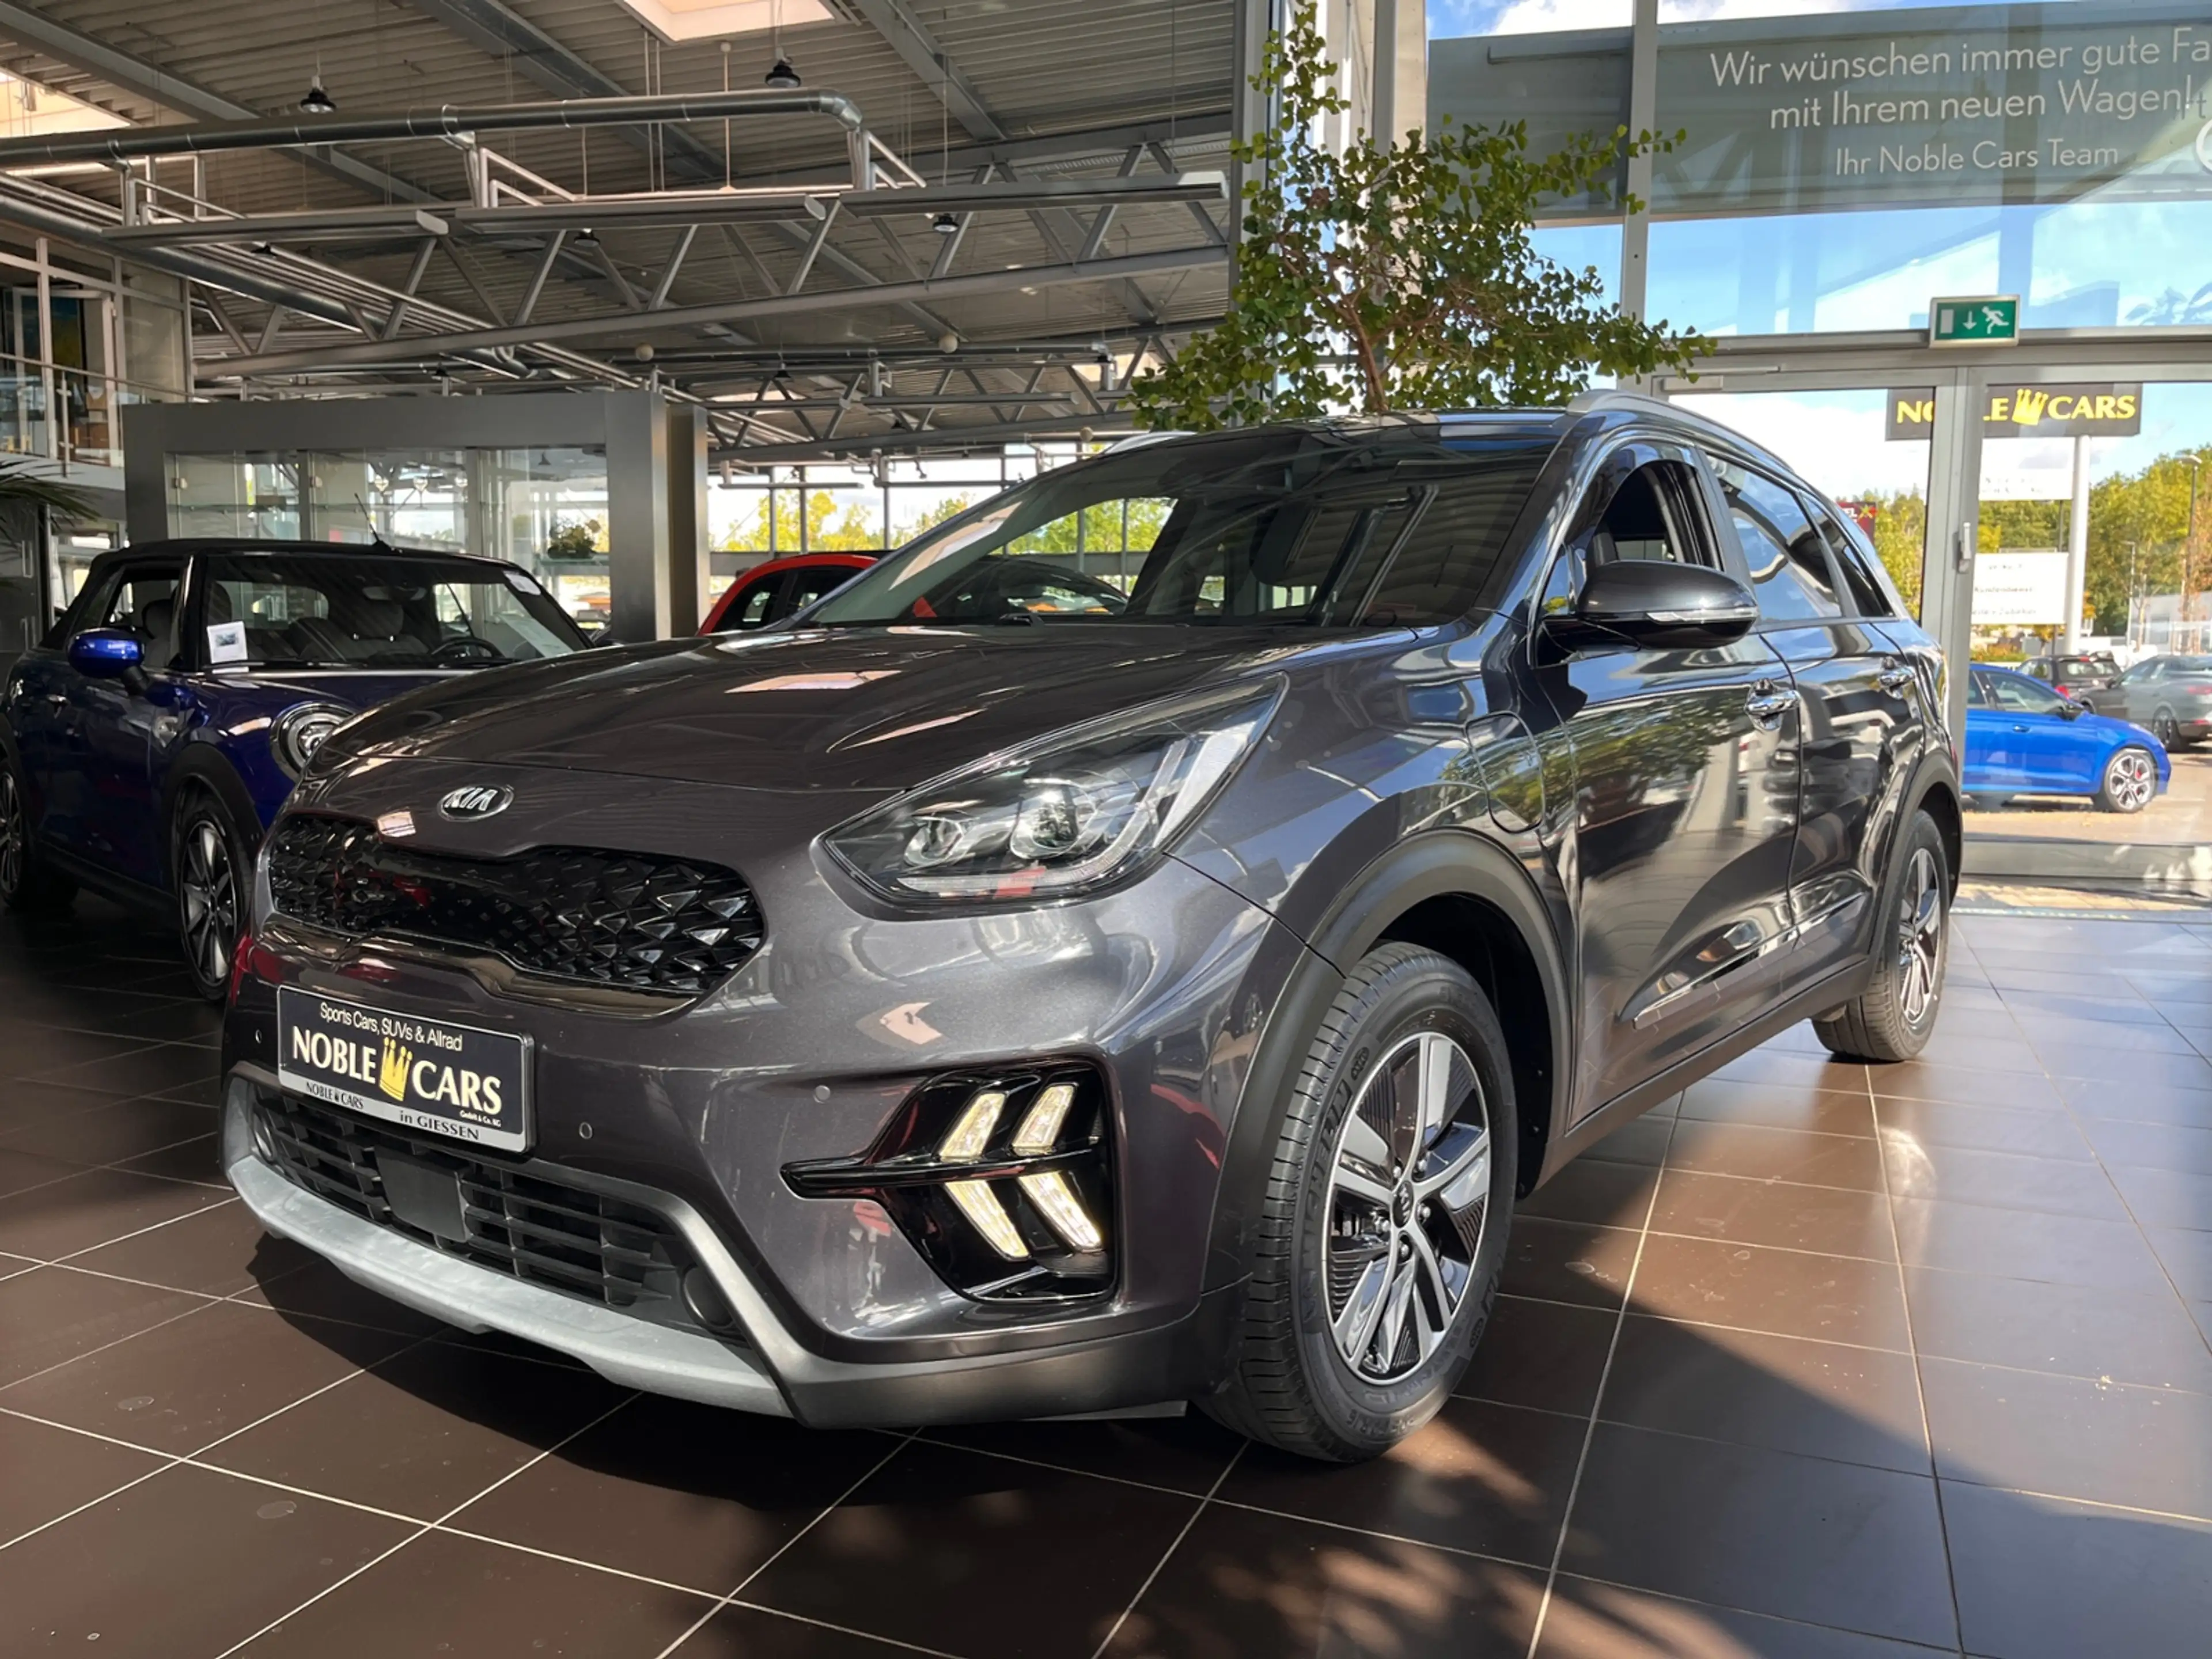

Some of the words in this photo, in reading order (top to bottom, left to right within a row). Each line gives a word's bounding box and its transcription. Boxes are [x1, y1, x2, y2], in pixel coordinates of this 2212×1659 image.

[1710, 51, 1770, 87] Wir
[1781, 41, 1950, 82] wünschen
[1962, 43, 2072, 71] immer
[2081, 36, 2160, 74] gute
[1770, 98, 1821, 130] mit
[1833, 92, 1928, 125] Ihrem
[1940, 92, 2046, 119] neuen
[1836, 147, 1868, 175] Ihr
[1880, 143, 1963, 172] Noble
[1972, 142, 2038, 168] Cars
[2047, 139, 2118, 166] Team
[2047, 396, 2136, 419] CARS
[444, 787, 498, 811] KIA
[320, 1002, 352, 1025] Sports
[415, 1026, 425, 1043] &
[426, 1028, 463, 1052] Allrad
[293, 1026, 377, 1085] NOBLE
[412, 1060, 502, 1115] CARS
[306, 1082, 332, 1100] NOBLE
[341, 1092, 364, 1109] CARS
[400, 1110, 413, 1124] in
[417, 1116, 479, 1141] GIESSEN
